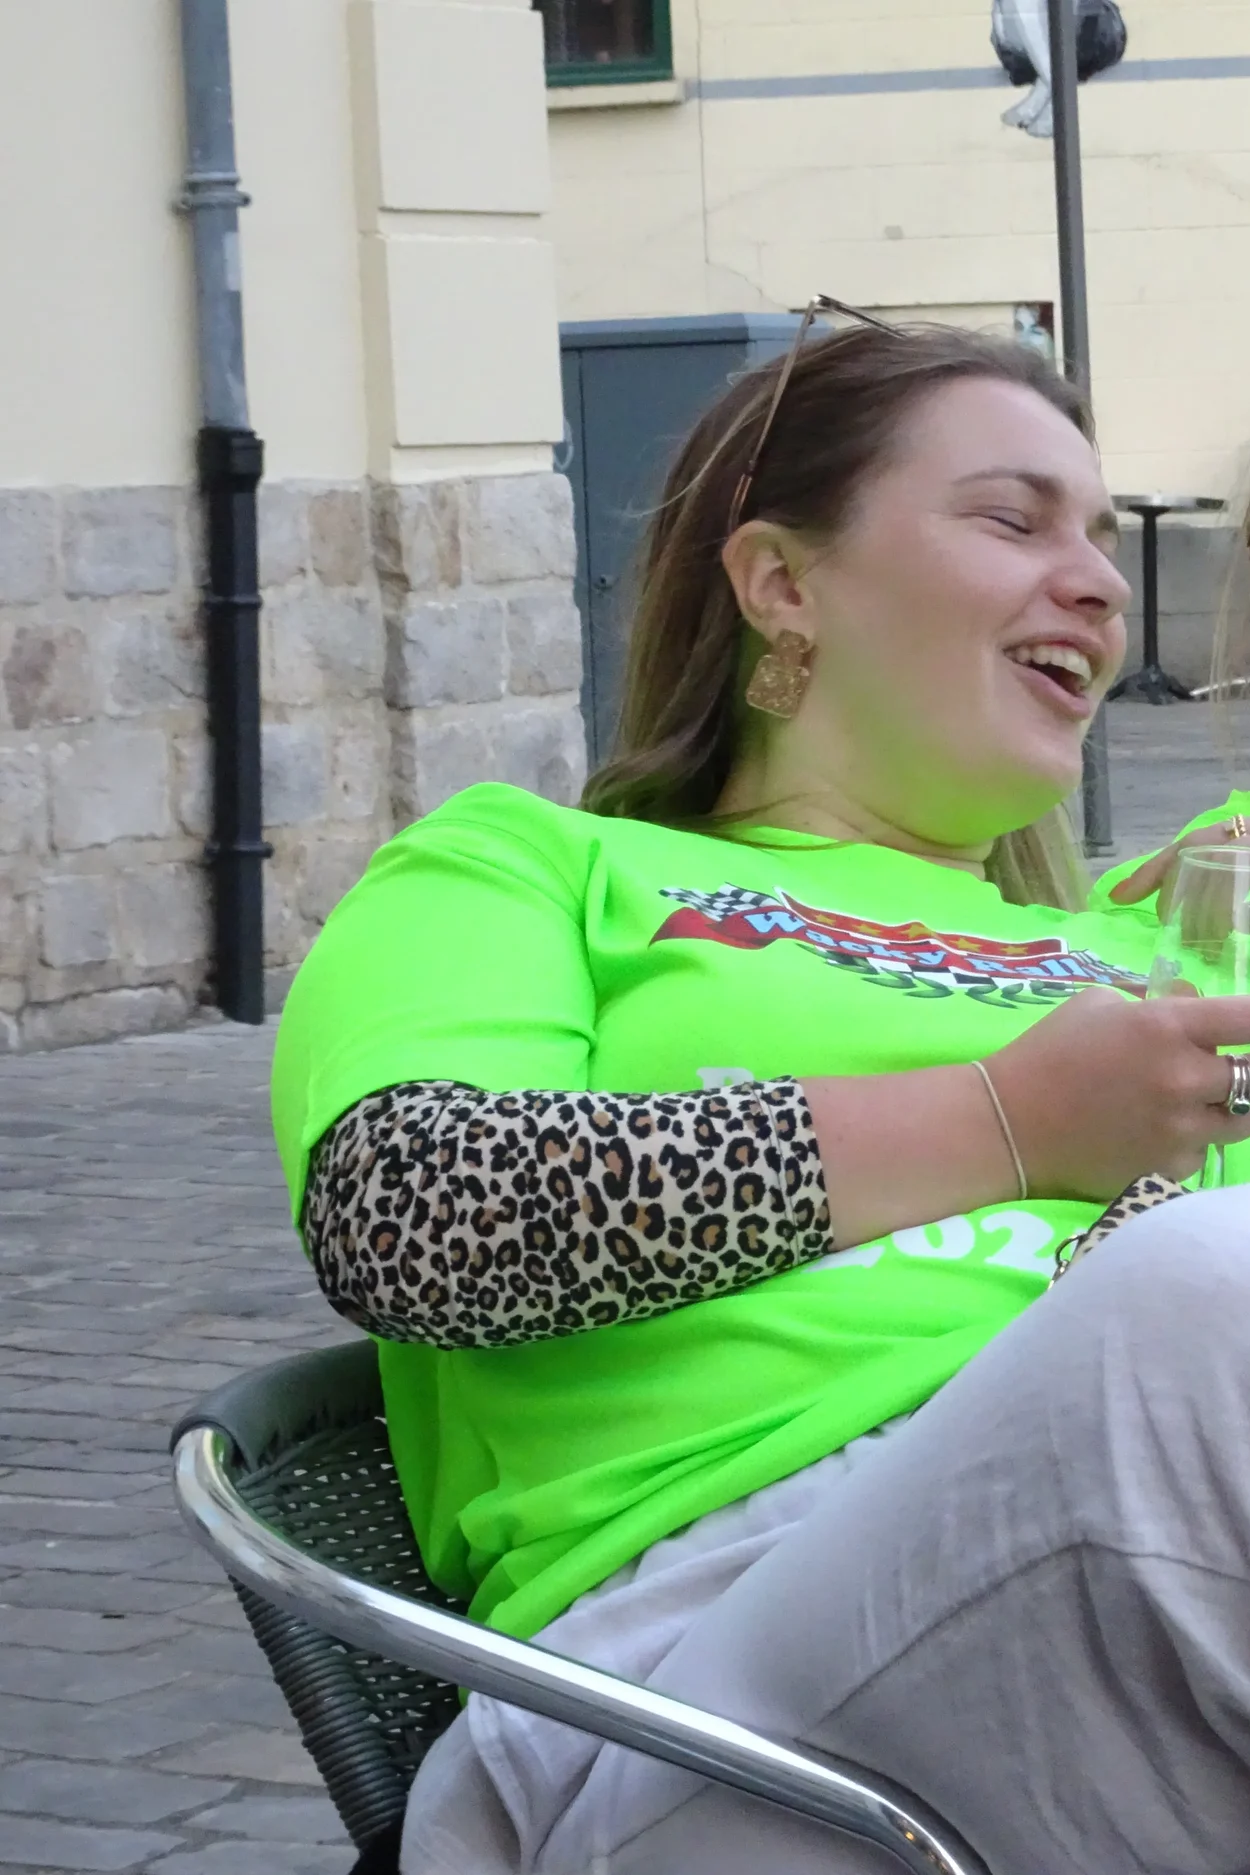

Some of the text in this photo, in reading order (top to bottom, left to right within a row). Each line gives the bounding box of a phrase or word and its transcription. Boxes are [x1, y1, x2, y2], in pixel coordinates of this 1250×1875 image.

[742, 909, 1113, 985] Wacky Rally
[802, 1209, 1090, 1278] 02
